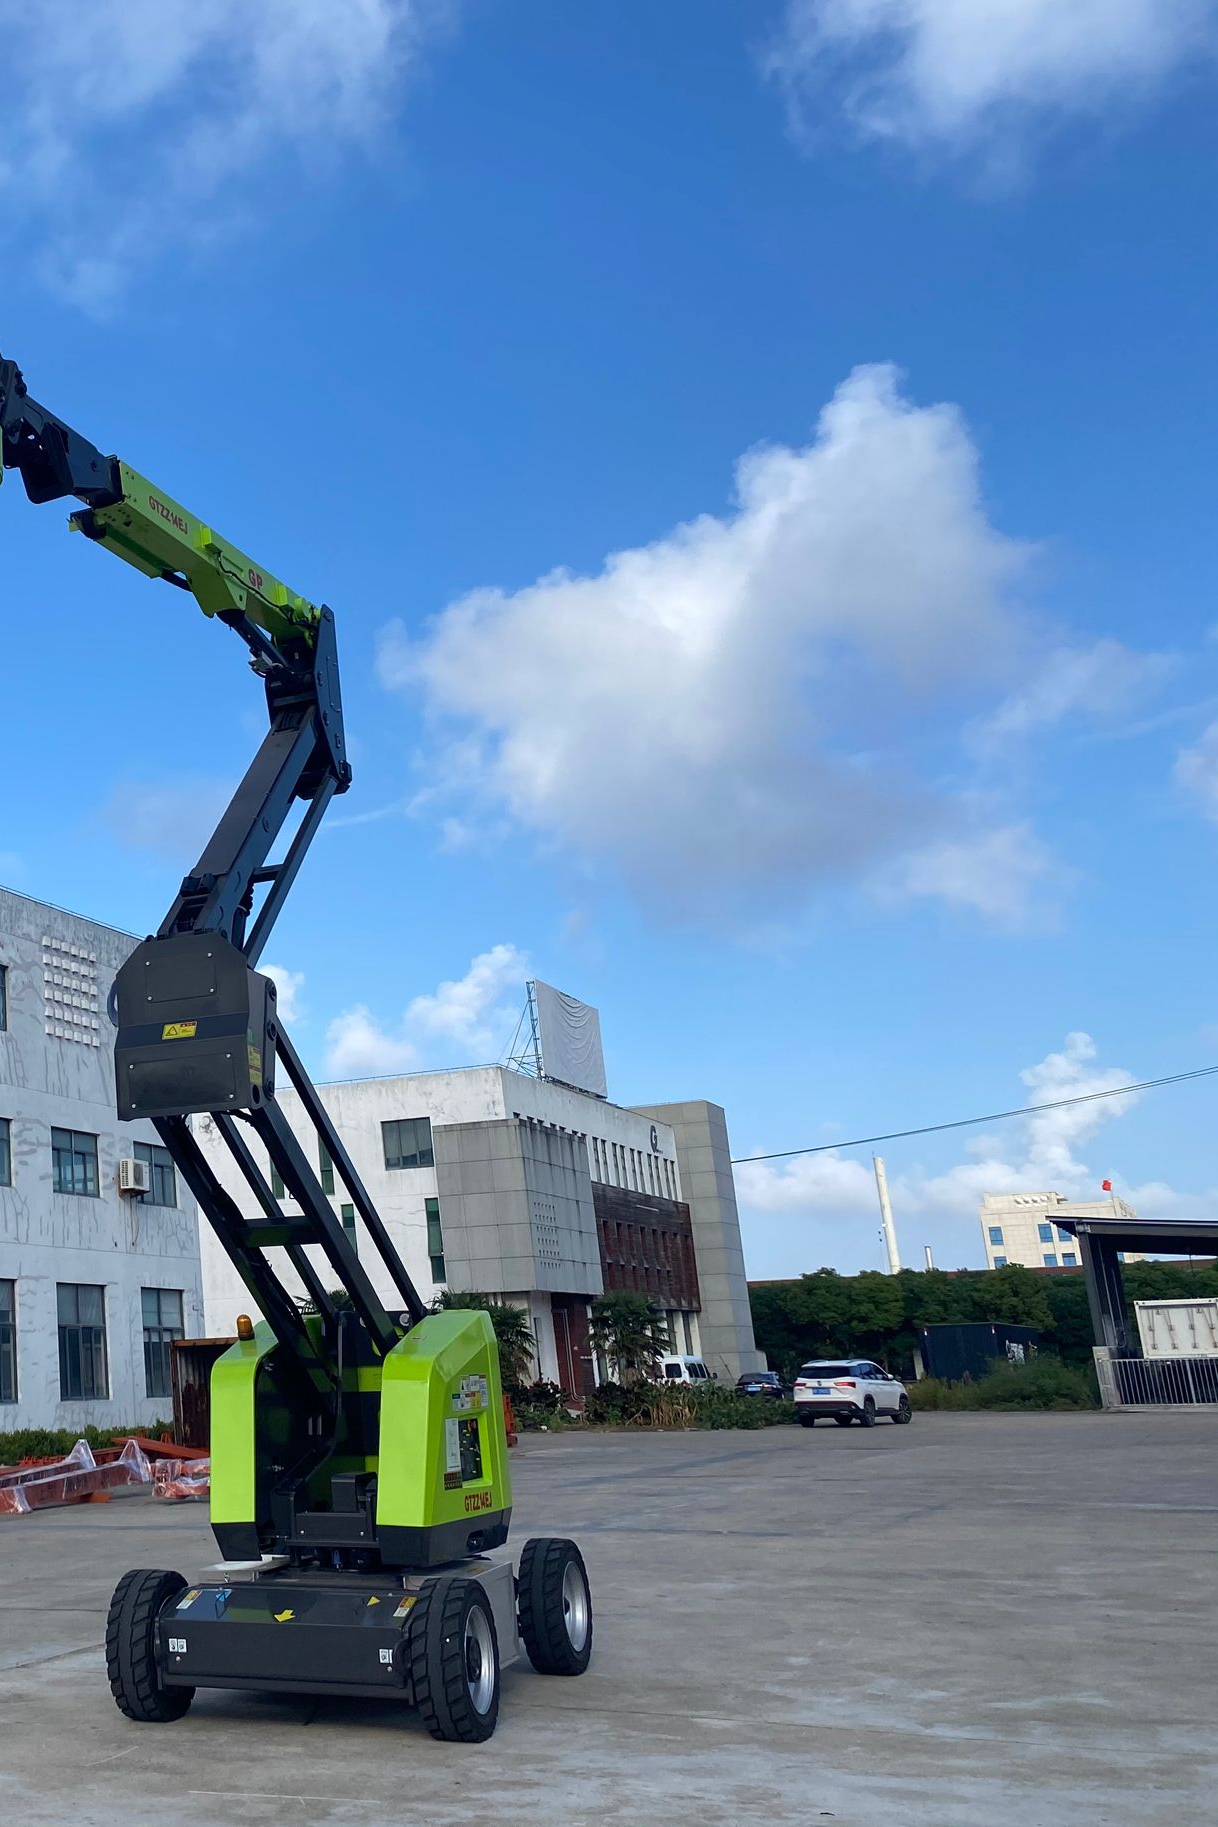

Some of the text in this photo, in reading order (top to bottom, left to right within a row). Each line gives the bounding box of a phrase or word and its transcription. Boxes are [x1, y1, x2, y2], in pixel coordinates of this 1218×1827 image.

[149, 495, 188, 535] GTZZ14EJ
[248, 568, 263, 590] GP
[464, 1491, 493, 1513] GTZZ14EJ
